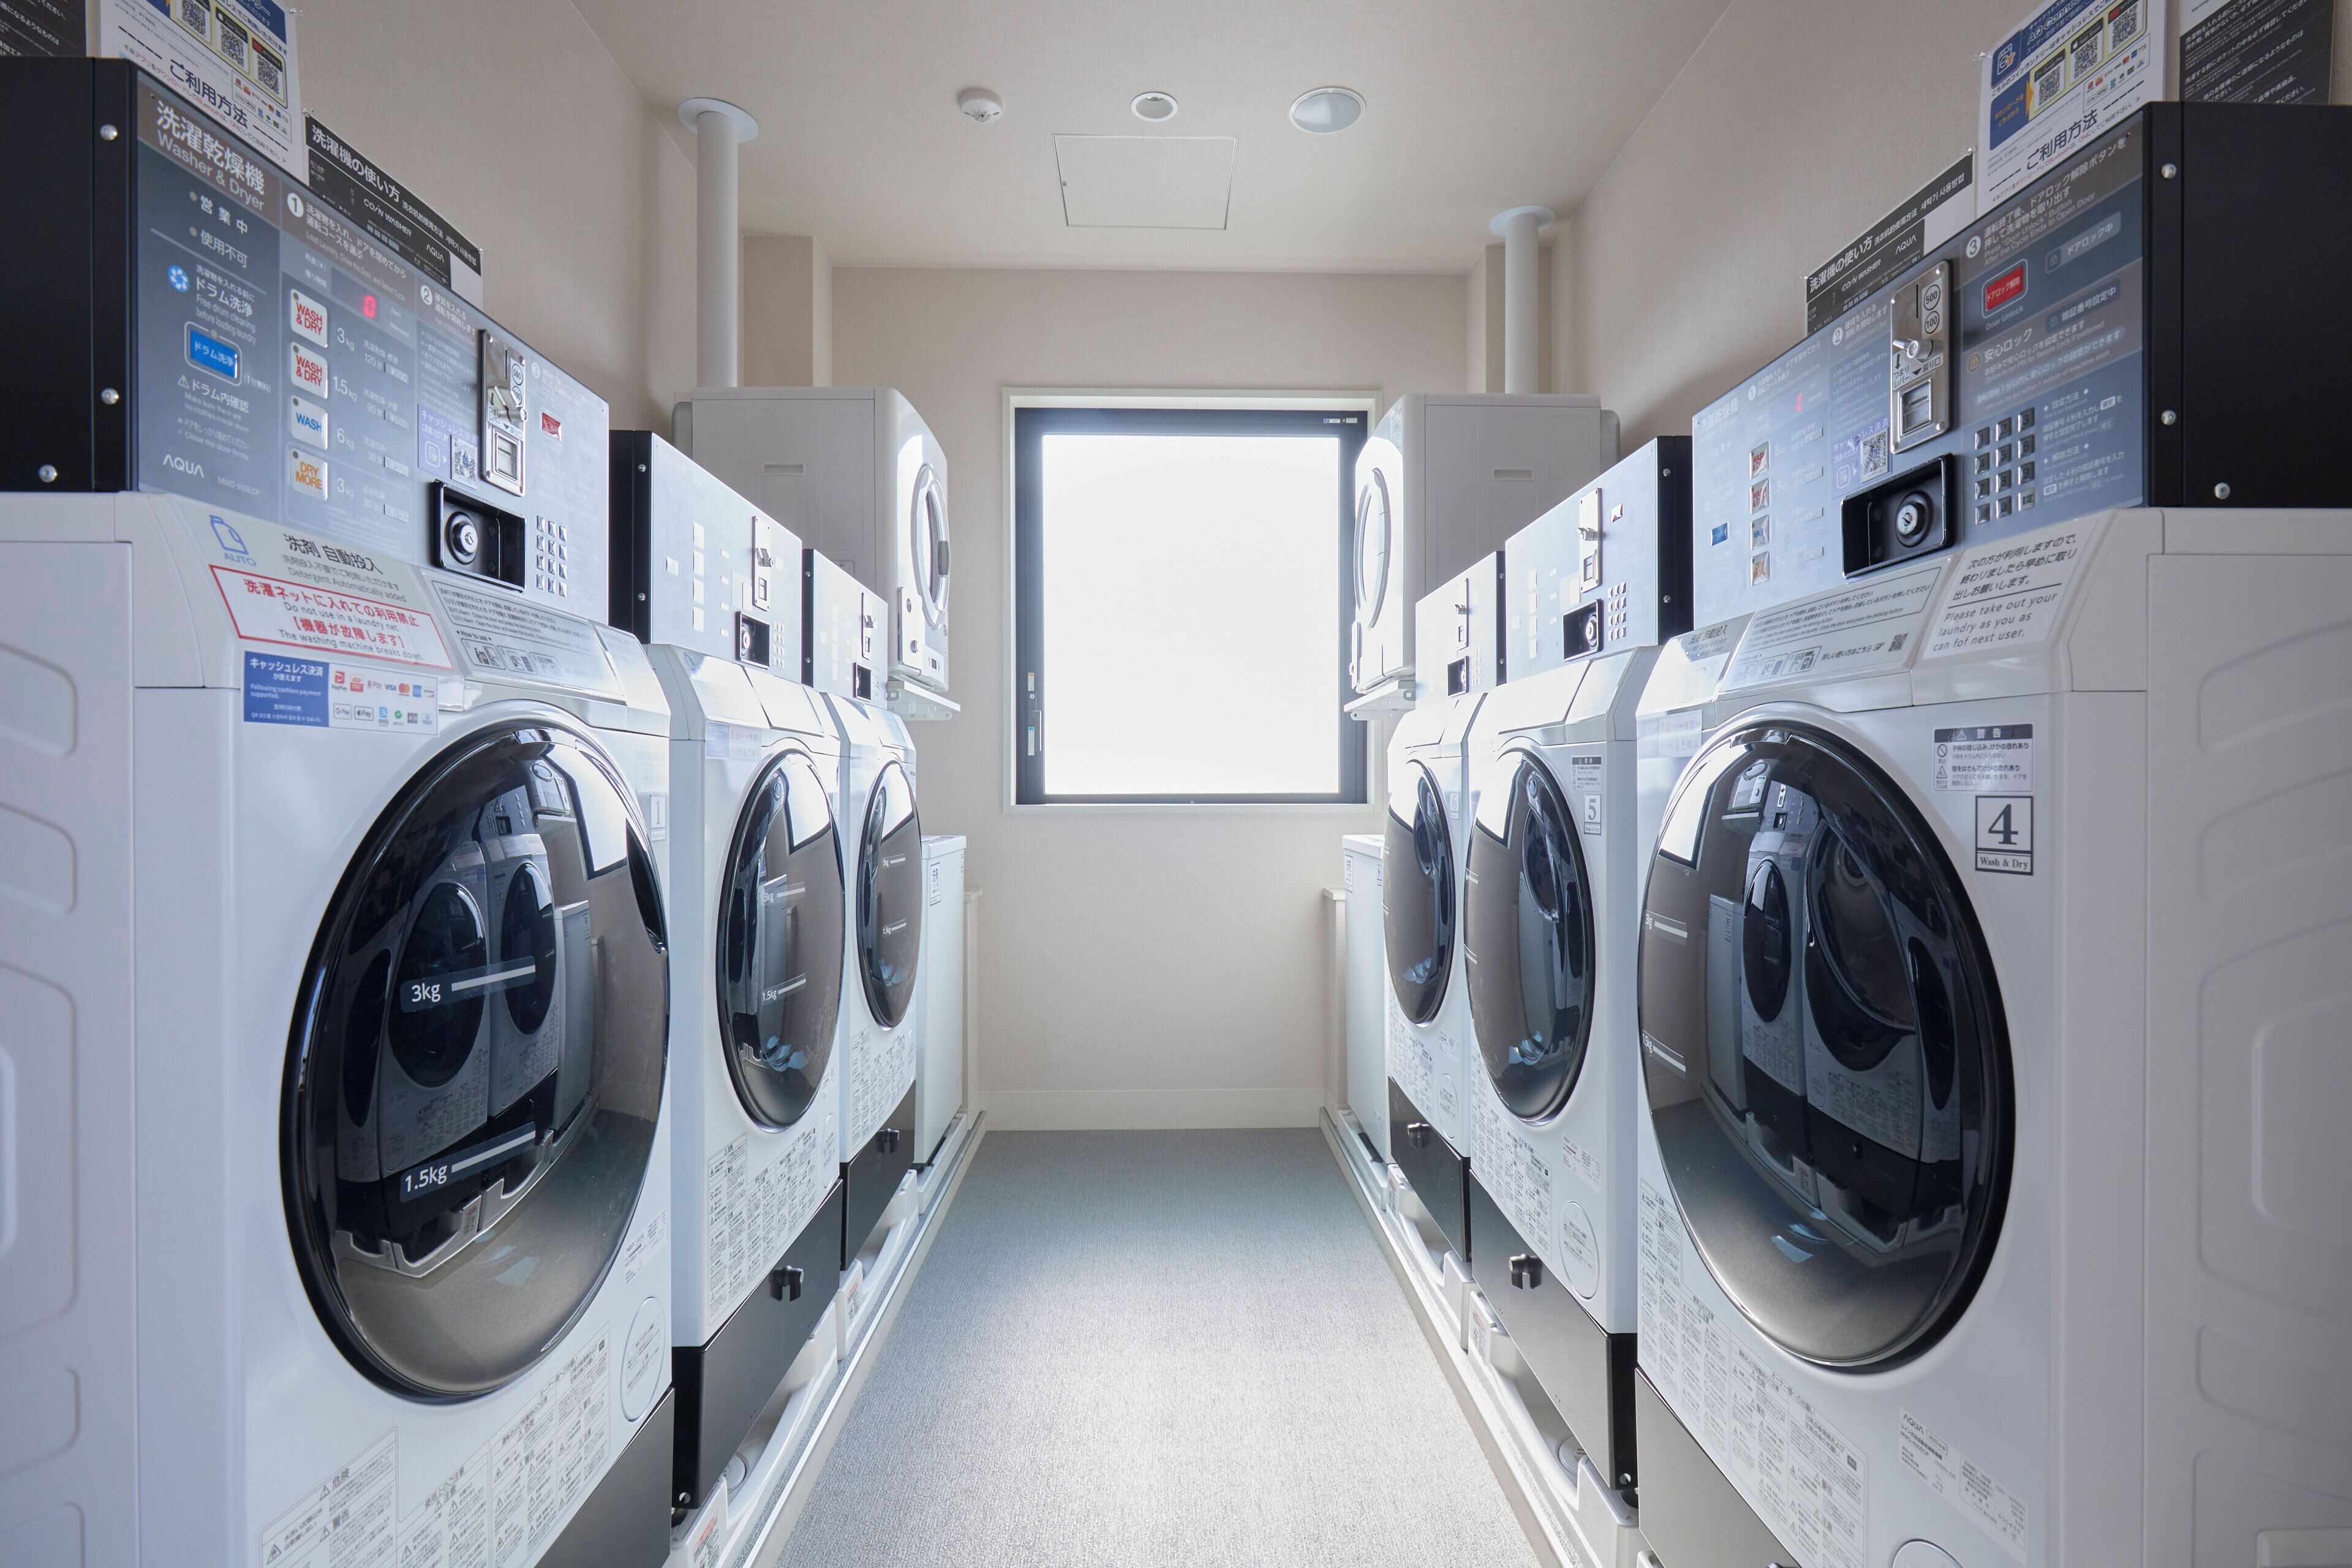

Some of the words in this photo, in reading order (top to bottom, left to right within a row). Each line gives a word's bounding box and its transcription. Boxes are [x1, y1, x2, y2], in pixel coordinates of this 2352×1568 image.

[170, 59, 248, 129] ご利用方法
[157, 99, 265, 195] 洗濯乾燥機
[2027, 108, 2098, 170] ご利用方法
[157, 129, 212, 177] Washer
[216, 170, 225, 187] &
[230, 178, 264, 211] Dryer
[312, 124, 400, 202] 洗濯機の使い方
[1984, 137, 2127, 238] 運転終了後、ドアロック解除ボタンを
[1984, 186, 2071, 250] 押して洗濯物を取り出す
[2049, 198, 2072, 217] Button
[385, 213, 412, 237] WASHER
[1985, 253, 1999, 266] After
[1999, 247, 2010, 258] the
[2011, 236, 2029, 254] Cycle
[2030, 227, 2047, 239] Ends
[2048, 222, 2056, 230] to
[2056, 208, 2076, 225] Open
[2077, 192, 2095, 207] Door
[201, 229, 248, 268] 使用不可
[306, 216, 363, 260] 運転コースを選ぶ
[1896, 235, 1917, 255] AQUA
[1969, 240, 1977, 255] 3
[2067, 223, 2114, 257] ドアロック中
[426, 244, 444, 263] AQUA
[1809, 235, 1873, 293] 洗濯機の使い方
[196, 263, 255, 303] 洗濯物を入れる前に
[1986, 276, 2021, 303] ドアロック解除
[197, 276, 252, 317] ドラム洗浄
[1926, 290, 1938, 304] 500
[2062, 286, 2117, 322] 暗証番号設定中
[197, 293, 211, 310] Free
[213, 301, 229, 317] drum
[230, 312, 255, 334] cleaning
[296, 301, 323, 325] WASH
[296, 314, 303, 325] &
[304, 317, 322, 336] DRY
[1926, 316, 1938, 330] 100
[1986, 318, 2000, 331] Door
[2002, 305, 2024, 323] Unlock
[197, 307, 214, 323] before
[216, 315, 235, 336] loading
[236, 326, 256, 347] laundry
[195, 341, 234, 367] ドラム洗浄
[1984, 327, 2033, 363] 安心ロック
[1984, 320, 2086, 377] お好みで安心ロックを設定できます
[296, 354, 323, 376] WASH
[1894, 367, 1910, 380] つまり
[1922, 356, 1941, 372] 戻り口
[296, 366, 302, 378] &
[304, 369, 322, 387] DRY
[1894, 375, 1910, 389] レバー
[185, 391, 202, 404] Make
[192, 379, 249, 413] ドラム内確認
[2052, 391, 2079, 410] 設定方法
[296, 412, 322, 433] WASH
[2000, 423, 2007, 435] 2
[2023, 413, 2029, 425] 3
[185, 431, 203, 444] Close
[2023, 441, 2029, 453] 6
[163, 454, 205, 478] AQUA
[300, 461, 319, 475] DRY
[2023, 467, 2029, 479] 9
[295, 472, 322, 491] MORE
[224, 552, 257, 567] AUTO
[284, 533, 321, 558] 洗剤
[322, 545, 383, 575] 自動投入
[1967, 533, 2077, 570] 次の方が利用しますので、
[1960, 548, 2079, 585] 終わりましたら早めに取り
[287, 566, 330, 587] Detergent
[333, 577, 383, 598] Automatically
[384, 589, 407, 603] added
[1952, 575, 2030, 601] 出しお願いします。
[243, 578, 420, 628] 洗濯ネットに入れての利用禁止
[1944, 608, 1977, 623] Please
[1979, 603, 2003, 616] take
[2007, 598, 2024, 610] out
[2027, 592, 2059, 609] your
[284, 601, 299, 612] Do
[301, 603, 317, 615] not
[318, 608, 334, 619] use
[337, 609, 346, 620] in
[355, 614, 385, 631] laundry
[385, 620, 401, 632] net.
[1938, 622, 1977, 638] laundry
[1979, 619, 1992, 630] as
[1995, 616, 2015, 631] you
[2019, 611, 2033, 622] as
[278, 628, 297, 640] The
[298, 631, 338, 649] washing
[339, 638, 374, 653] machine
[376, 644, 401, 657] breaks
[402, 647, 425, 661] down.
[292, 616, 405, 649] 【機器が故障します】
[1932, 642, 1950, 652] can
[1952, 635, 1969, 648] fof
[1971, 633, 1994, 647] next
[1997, 628, 2026, 641] user.
[1821, 644, 1872, 662] 詳しい使い方はこちら
[250, 657, 324, 677] キャッシュレス決済
[273, 673, 302, 683] が使えます
[251, 683, 277, 693] Following
[277, 686, 300, 695] cashless
[361, 709, 372, 718] Pay
[655, 801, 661, 824] 1
[1588, 798, 1597, 820] 5
[1988, 803, 2019, 845] 4
[1980, 856, 2000, 867] Wash
[2002, 859, 2010, 868] &
[2012, 859, 2029, 870] Dry
[763, 891, 774, 903] 3kg
[411, 983, 440, 1003] 3kg
[762, 989, 777, 1001] 1.5kg
[1642, 1033, 1653, 1054] 1.5kg
[405, 1165, 447, 1193] 1.5kg
[1903, 1413, 1924, 1435] AQUA
